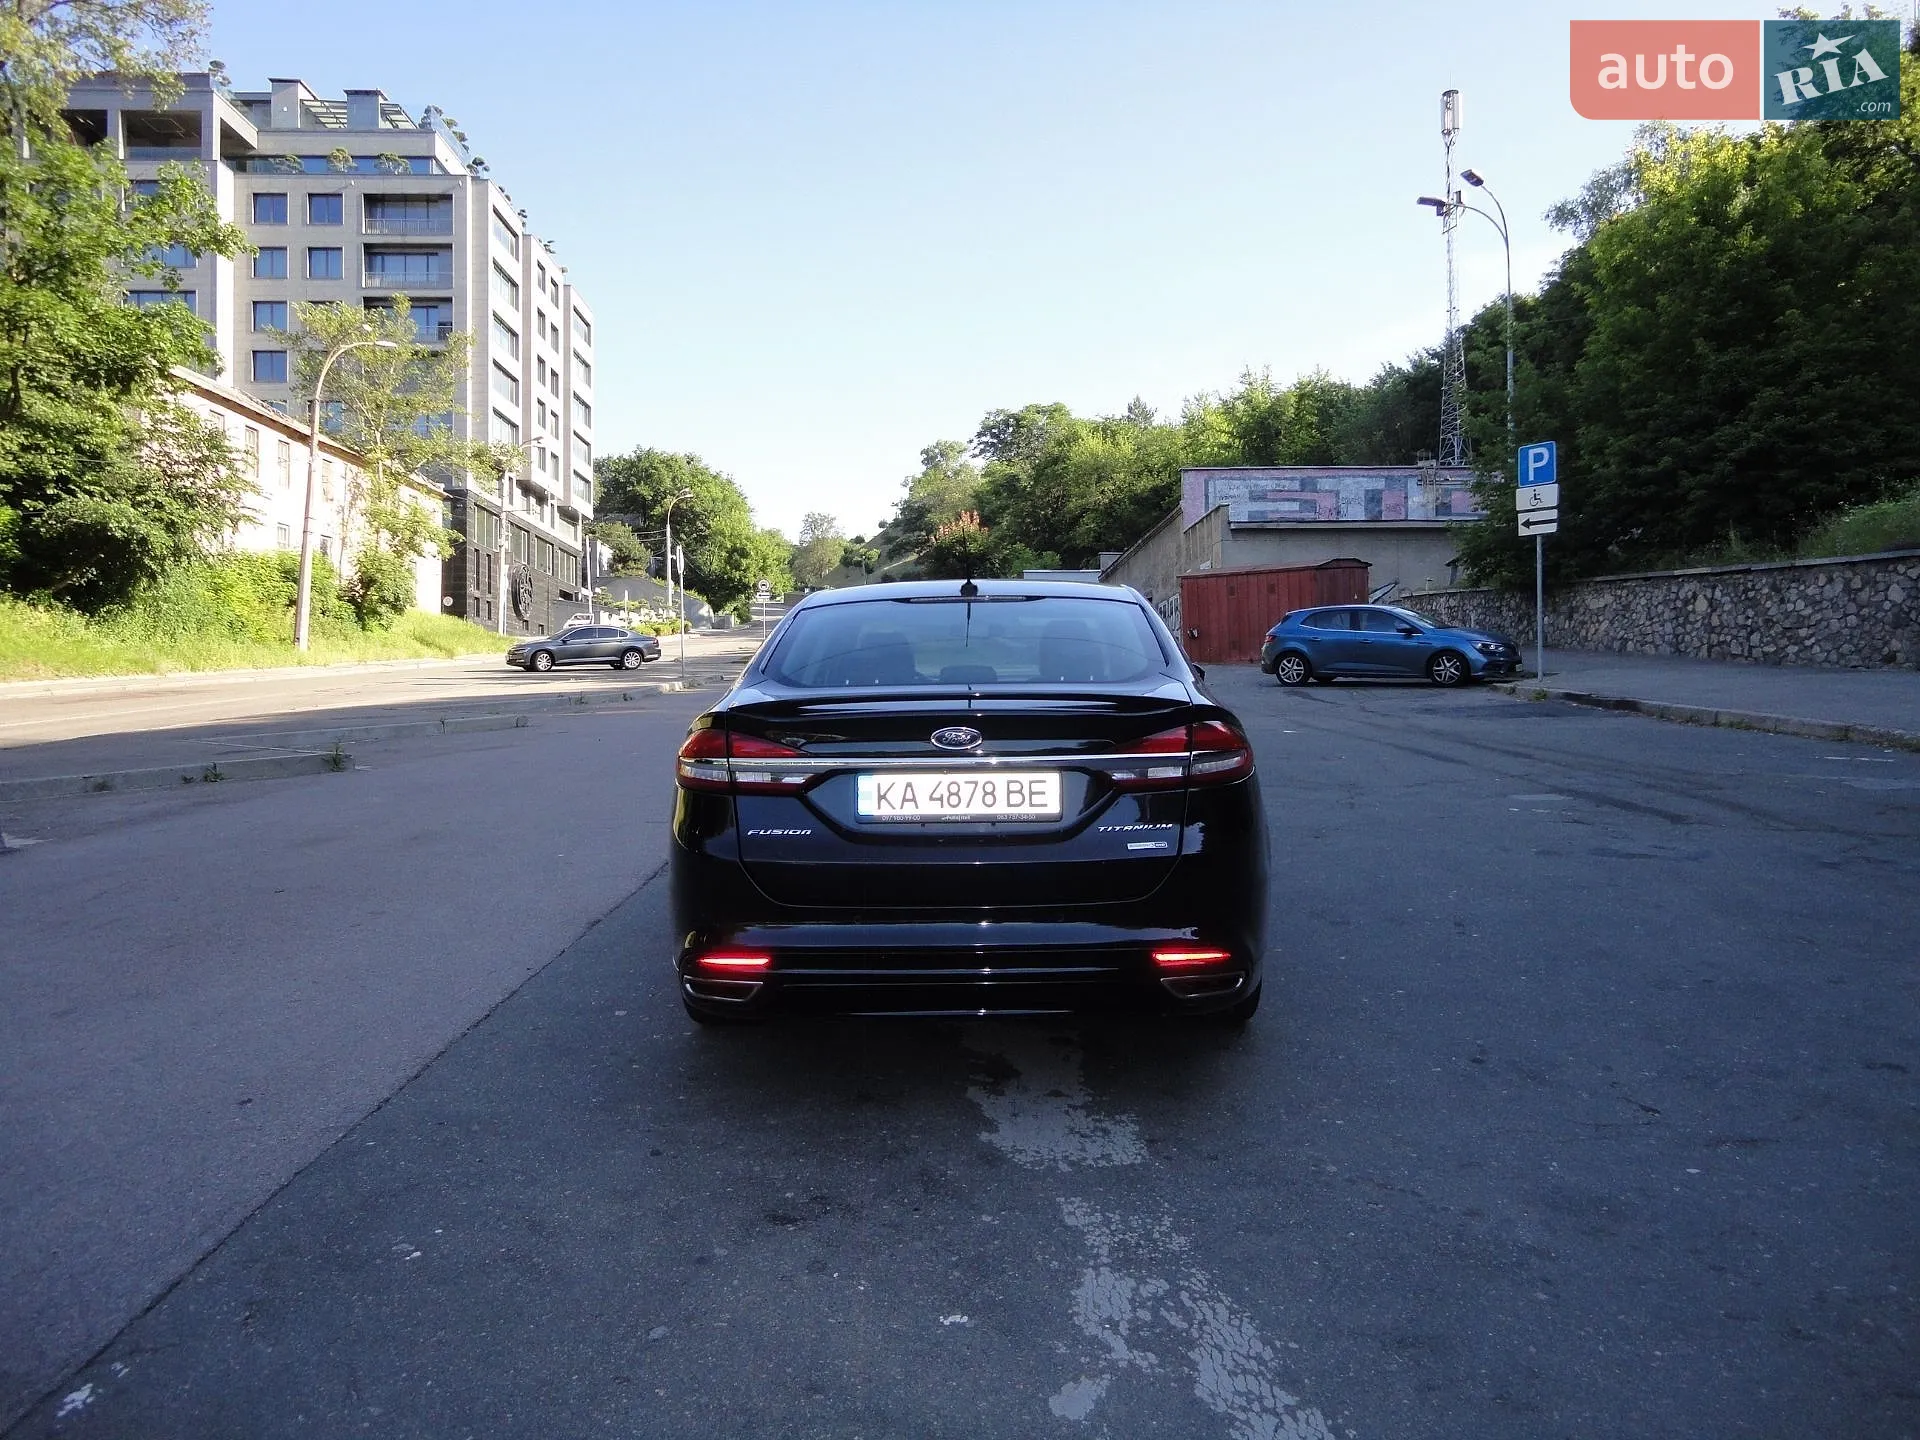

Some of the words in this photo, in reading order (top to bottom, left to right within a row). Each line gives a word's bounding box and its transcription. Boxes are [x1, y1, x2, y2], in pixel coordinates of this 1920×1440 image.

[1528, 447, 1550, 481] P
[876, 781, 919, 810] KA
[929, 780, 996, 809] 4878
[1006, 779, 1048, 808] BE
[1098, 823, 1173, 832] TITANIUM
